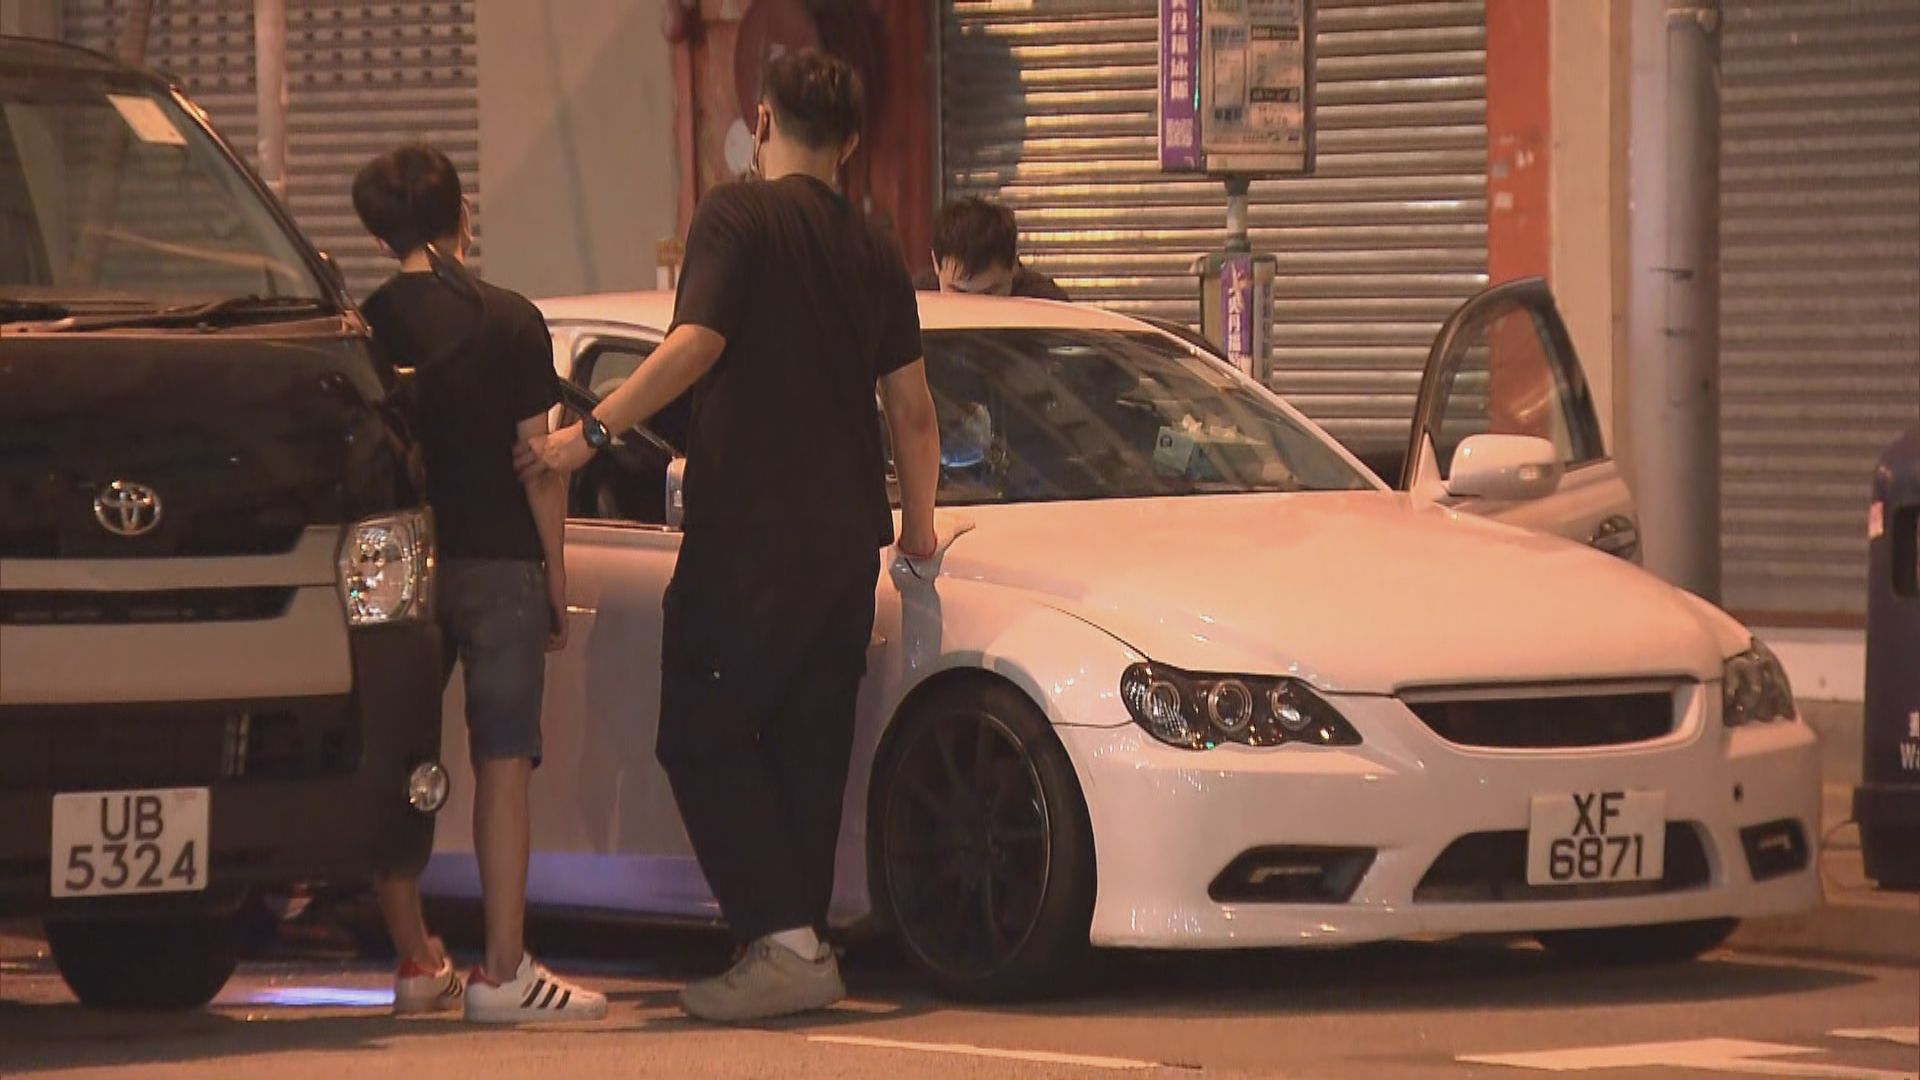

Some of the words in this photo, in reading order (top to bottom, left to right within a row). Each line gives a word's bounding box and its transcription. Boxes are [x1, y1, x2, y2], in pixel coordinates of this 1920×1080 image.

[101, 796, 164, 841] UB
[1572, 792, 1625, 836] XF
[65, 840, 197, 891] 5324
[1550, 834, 1643, 880] 6871
